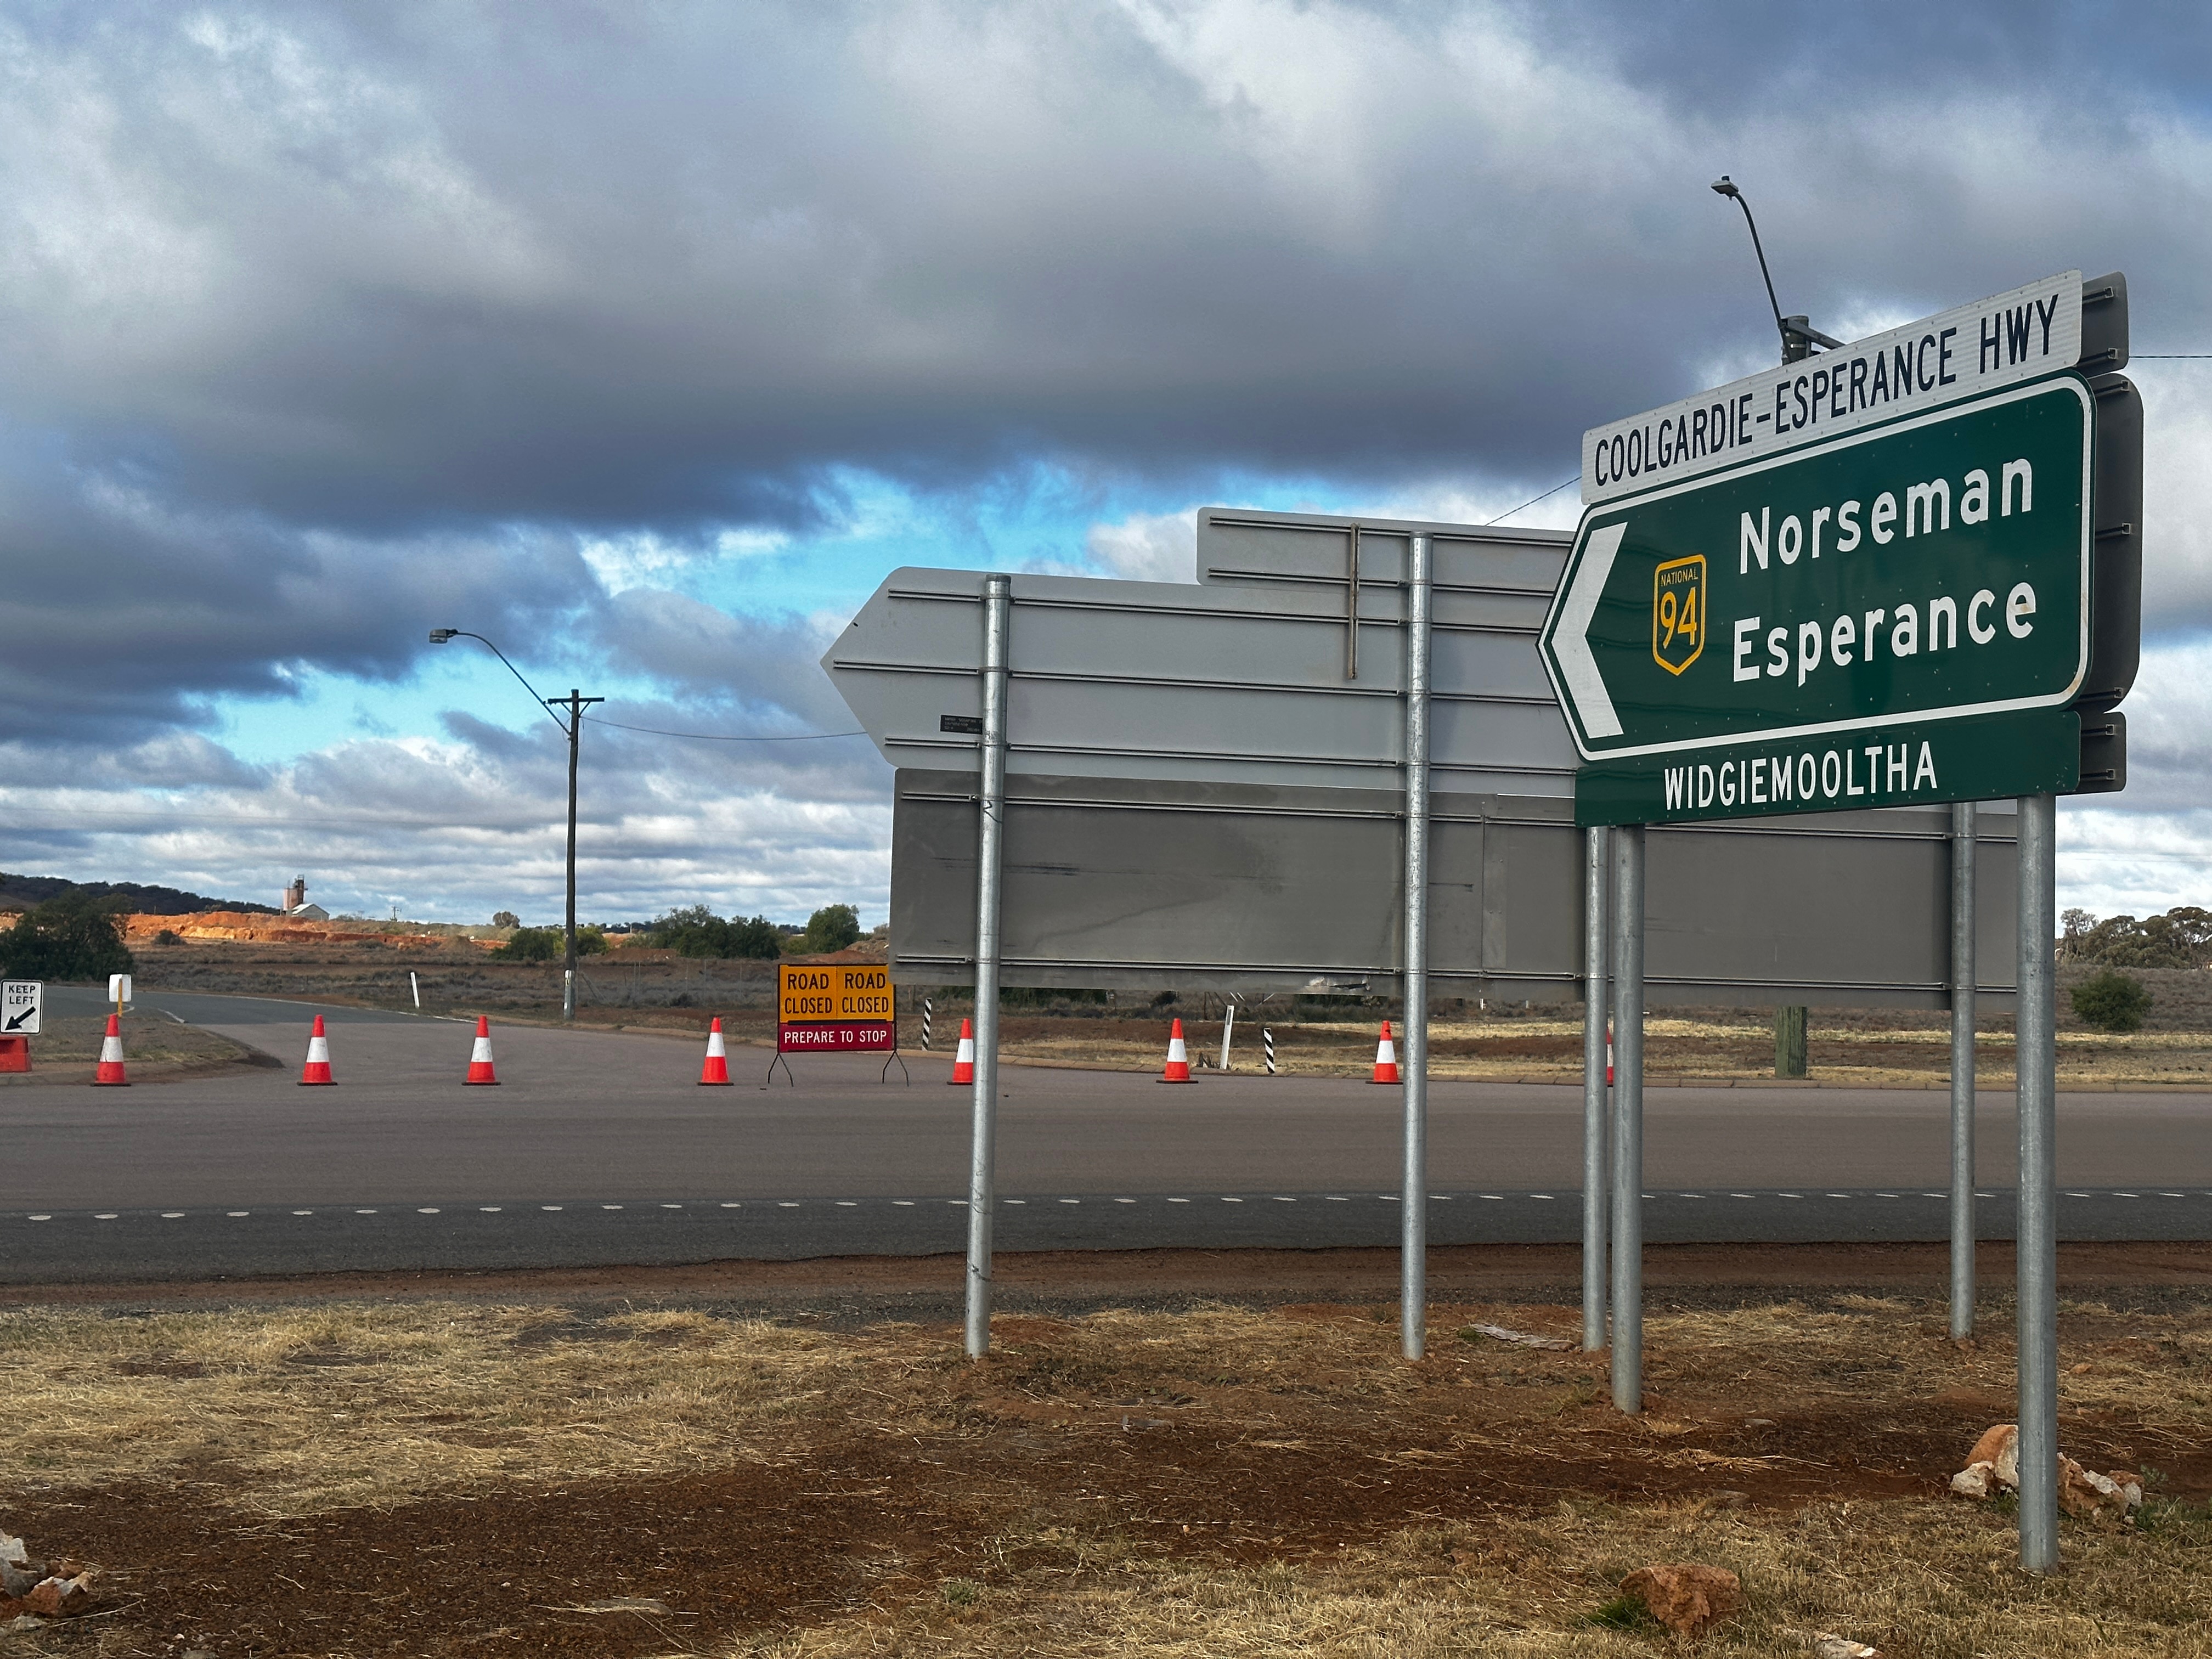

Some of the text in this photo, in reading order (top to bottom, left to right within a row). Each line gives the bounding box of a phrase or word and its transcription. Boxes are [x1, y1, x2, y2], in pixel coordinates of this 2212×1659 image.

[1595, 294, 2058, 487] COOLGARDIE-ESPERANCE HWY
[1739, 458, 2032, 574] Norseman
[1661, 567, 1699, 586] NATIONAL
[1660, 586, 1697, 649] 94
[1733, 582, 2036, 686] Esperance
[1664, 741, 1938, 810] WIDGIEMOOLTHA
[8, 985, 36, 994] KEEP
[788, 973, 829, 990] ROAD
[844, 973, 886, 989] ROAD
[9, 996, 34, 1005] LEFT
[785, 997, 832, 1014] CLOSED
[842, 996, 889, 1013] CLOSED
[785, 1030, 887, 1043] PREPARE TO STOP
